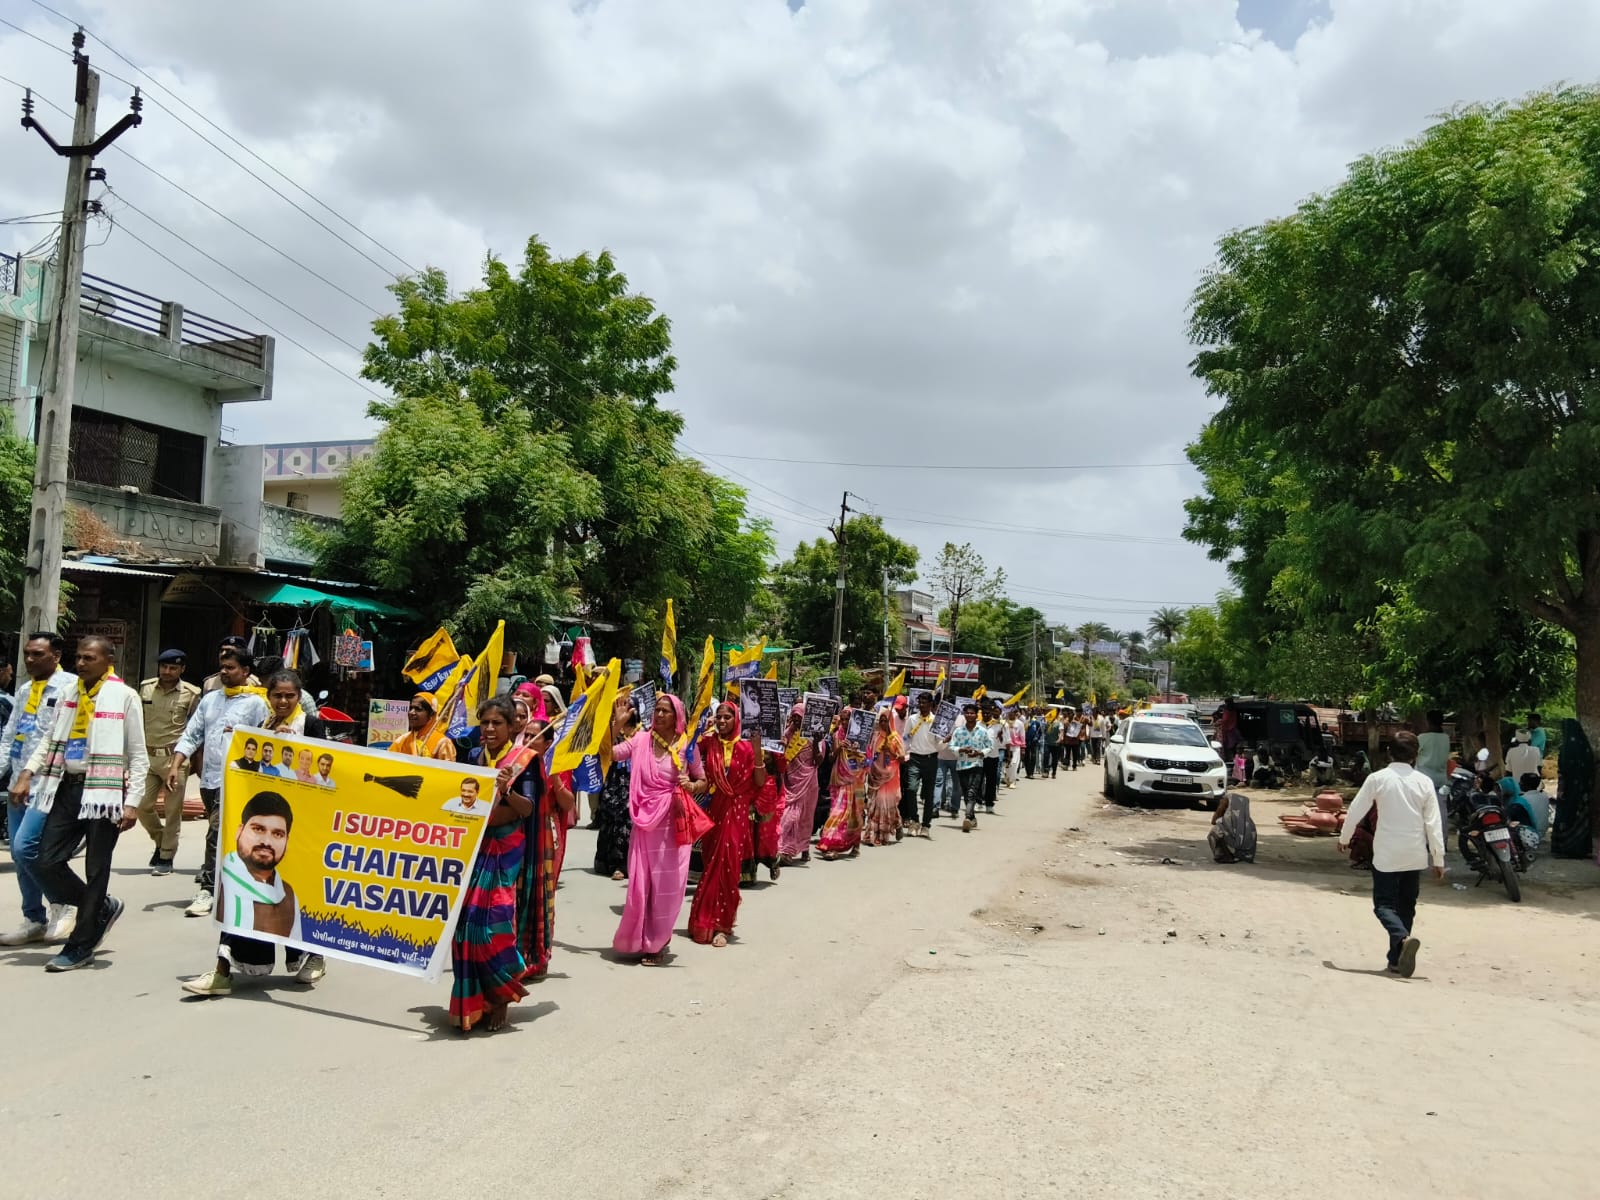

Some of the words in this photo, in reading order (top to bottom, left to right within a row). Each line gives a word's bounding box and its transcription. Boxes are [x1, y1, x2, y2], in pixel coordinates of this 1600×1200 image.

[333, 811, 342, 831] I
[345, 813, 467, 848] SUPPORT
[323, 843, 465, 886] CHAITAR
[324, 877, 449, 921] VASAVA
[360, 942, 375, 953] આમ
[377, 945, 400, 958] આદમી
